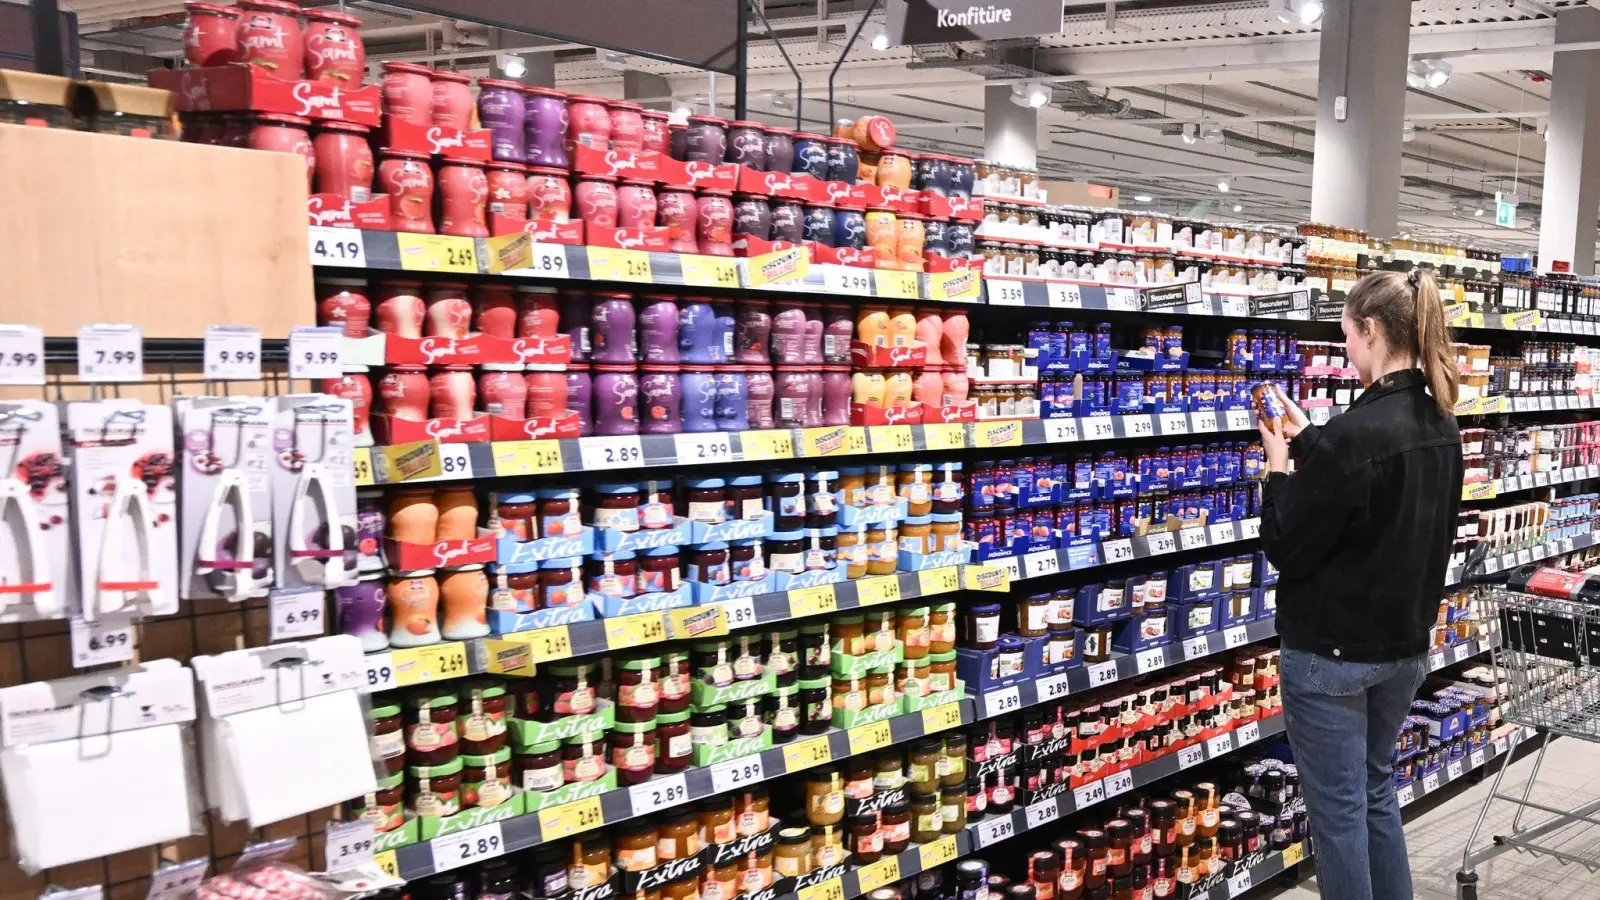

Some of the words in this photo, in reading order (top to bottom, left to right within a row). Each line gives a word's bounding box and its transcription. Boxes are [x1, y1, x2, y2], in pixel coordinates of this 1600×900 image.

[937, 6, 1011, 27] Konfitüre
[292, 83, 345, 116] Samt
[427, 127, 466, 154] Samt
[604, 151, 638, 175] Samt
[685, 162, 717, 185] Samt
[765, 174, 794, 195] Samt
[826, 183, 852, 203] Samt
[880, 186, 903, 206] Samt
[307, 197, 354, 226] Samt
[614, 230, 646, 249] Samt
[314, 240, 359, 259] 4.19
[448, 247, 472, 266] 2.69
[842, 275, 867, 290] 2.99
[1001, 289, 1022, 300] 3.59
[1061, 291, 1079, 303] 3.59
[1151, 292, 1183, 302] Besonderes
[1259, 300, 1290, 309] Besonderes
[95, 350, 136, 364] 7.99
[220, 350, 255, 363] 9.99
[304, 350, 339, 363] 9.99
[420, 339, 458, 364] Samt
[513, 339, 547, 364] Samt
[890, 348, 913, 366] Samt
[885, 408, 906, 425] Samt
[942, 407, 962, 424] Samt
[1202, 419, 1216, 429] 2.79
[1236, 417, 1249, 427] 2.79
[426, 419, 465, 439] Samt
[523, 419, 557, 438] Samt
[1057, 426, 1076, 438] 2.79
[1096, 423, 1112, 434] 3.19
[1135, 422, 1151, 432] 2.99
[1171, 420, 1186, 430] 2.79
[606, 443, 639, 462] 2.89
[696, 443, 727, 458] 2.99
[854, 507, 899, 525] Extra
[617, 532, 684, 550] Extra
[703, 521, 766, 543] Extra
[1190, 534, 1205, 545] 2.99
[1220, 529, 1234, 539] 3.19
[512, 540, 584, 562] Extra
[1115, 546, 1132, 558] 2.79
[1158, 539, 1174, 550] 2.99
[433, 542, 471, 568] Samt
[920, 552, 965, 570] Extra
[1038, 558, 1057, 571] 2.79
[785, 571, 841, 591] Extra
[713, 582, 768, 599] Extra
[621, 595, 685, 611] Extra
[287, 609, 320, 624] 6.99
[512, 606, 588, 632] Extra
[88, 632, 127, 651] 6.99
[1233, 631, 1246, 643] 2.89
[1192, 643, 1207, 655] 2.89
[439, 653, 464, 672] 2.69
[851, 648, 899, 672] Extra
[1147, 654, 1163, 667] 2.89
[1099, 668, 1116, 682] 2.89
[716, 681, 769, 704] Extra
[1049, 681, 1067, 696] 2.89
[919, 690, 958, 708] Extra
[998, 695, 1018, 710] 2.89
[851, 703, 899, 727] Extra
[946, 709, 959, 724] 2.69
[536, 713, 606, 741] Extra
[1245, 728, 1258, 740] 2.49
[709, 737, 764, 761] Extra
[1032, 737, 1068, 760] Extra
[1216, 739, 1231, 752] 2.89
[976, 754, 1017, 776] Extra
[1188, 750, 1202, 763] 2.89
[732, 763, 760, 783] 2.89
[1115, 777, 1132, 790] 2.49
[541, 784, 608, 807] Extra
[652, 785, 684, 805] 2.89
[856, 788, 904, 816] Extra
[1031, 783, 1067, 804] Extra
[1086, 787, 1103, 801] 2.49
[1229, 794, 1245, 804] Extra
[439, 805, 513, 834] Extra
[1038, 805, 1057, 821] 2.89
[991, 822, 1012, 839] 2.89
[340, 839, 372, 857] 3.99
[460, 835, 499, 858] 2.89
[714, 832, 773, 863] Extra
[943, 843, 956, 857] 2.69
[884, 864, 897, 878] 2.69
[1233, 852, 1265, 874] Extra
[635, 857, 700, 891] Extra
[794, 863, 846, 890] Extra
[1237, 876, 1250, 889] 4.19
[1189, 874, 1224, 898] Extra
